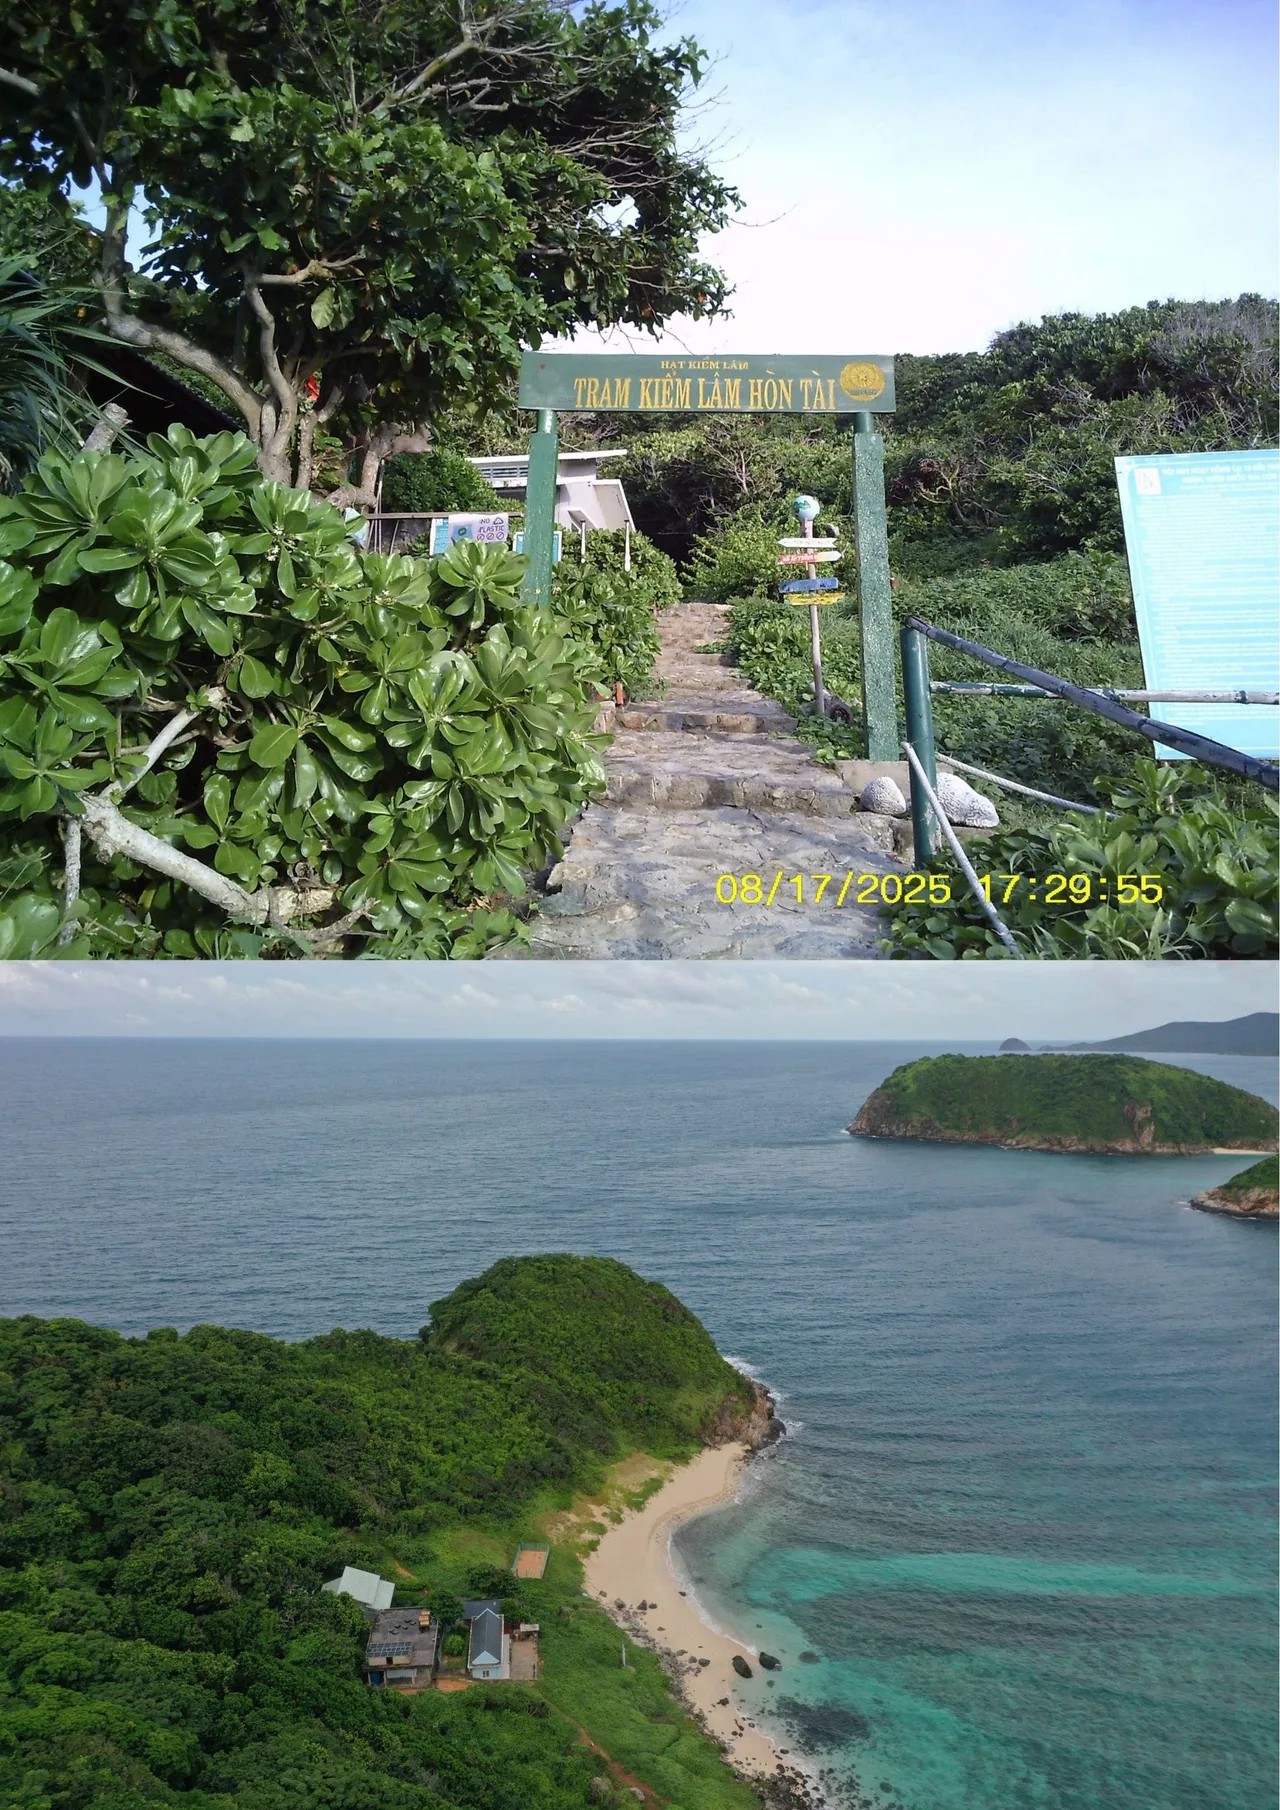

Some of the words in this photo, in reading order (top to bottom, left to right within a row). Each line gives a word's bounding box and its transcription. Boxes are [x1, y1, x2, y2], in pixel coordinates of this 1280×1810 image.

[661, 361, 686, 371] HẠT
[689, 356, 719, 369] KIỂM
[639, 371, 692, 409] KIỂM
[698, 372, 742, 409] LÂM
[748, 370, 794, 410] HÒN
[800, 370, 836, 410] TÀI
[478, 525, 505, 533] PLASTIC
